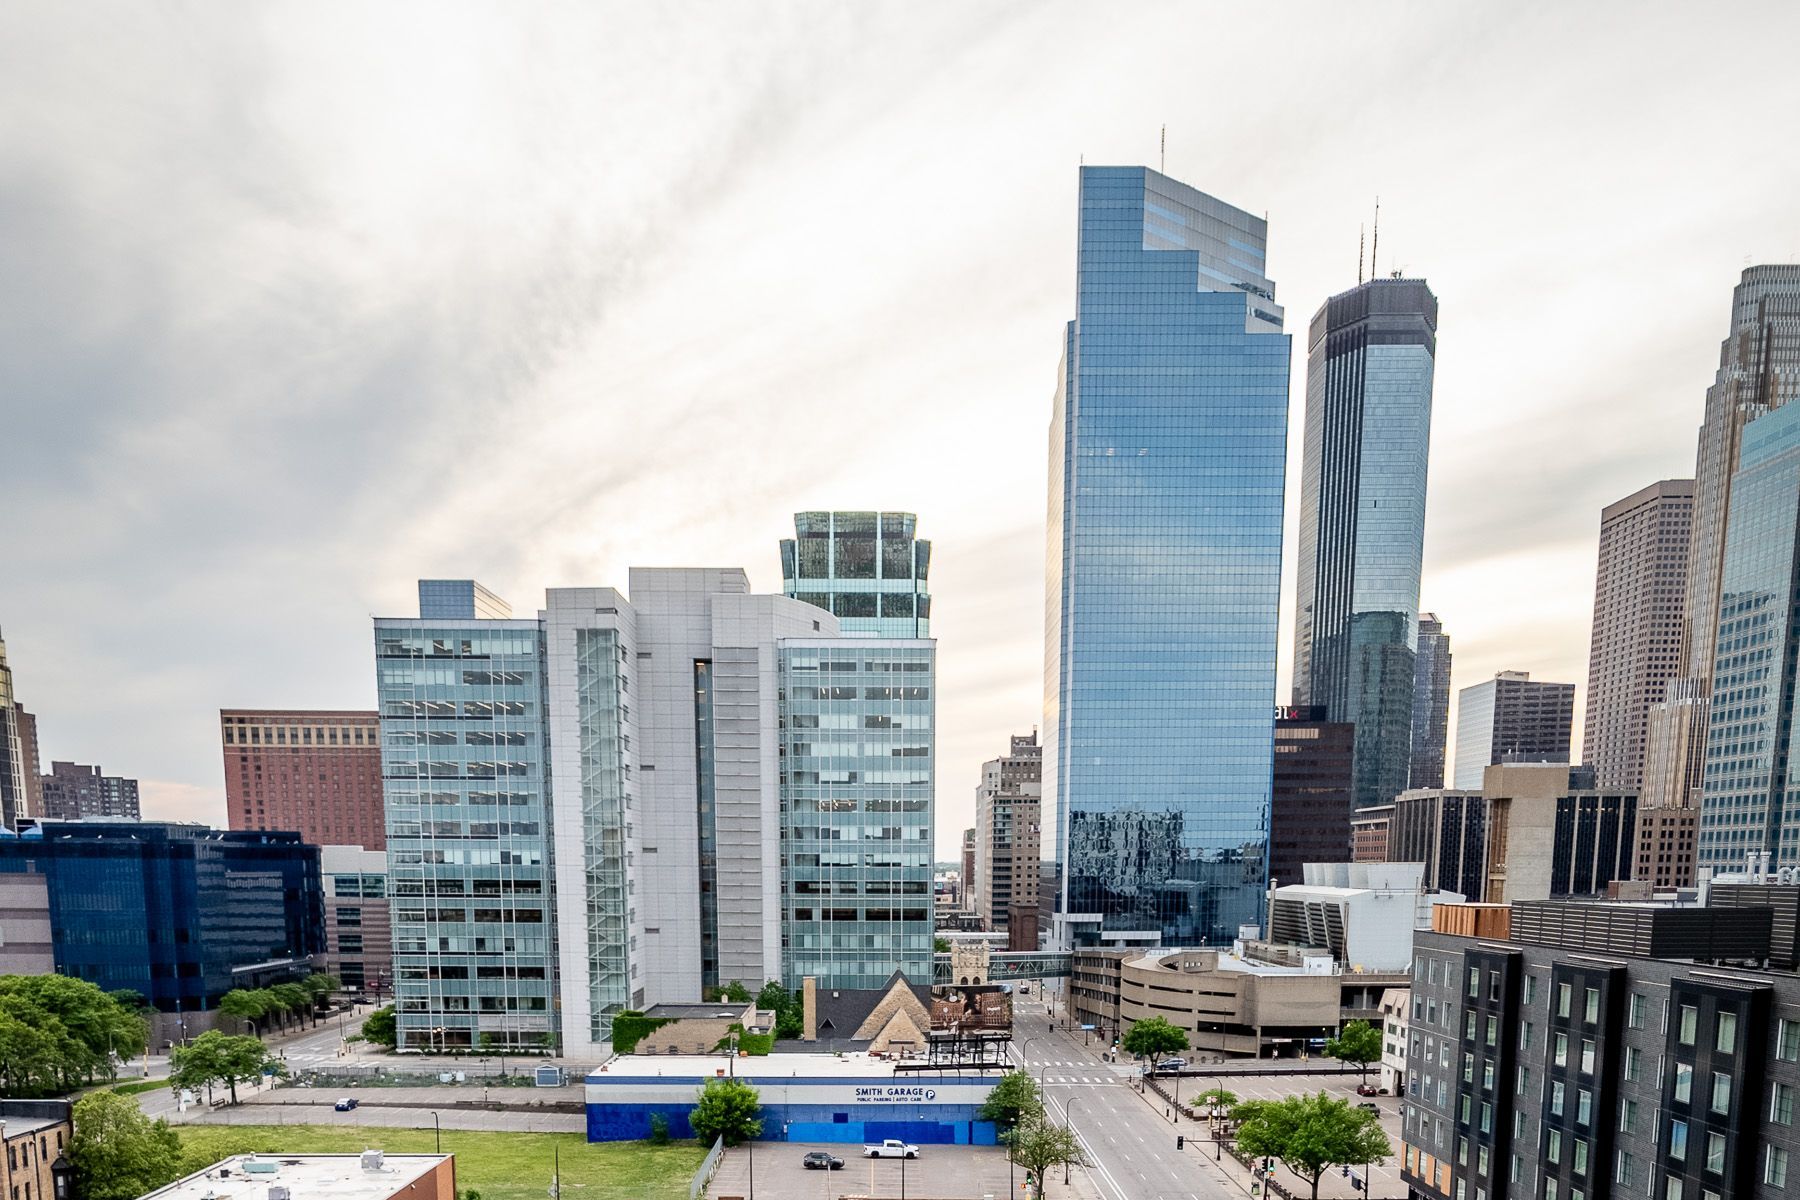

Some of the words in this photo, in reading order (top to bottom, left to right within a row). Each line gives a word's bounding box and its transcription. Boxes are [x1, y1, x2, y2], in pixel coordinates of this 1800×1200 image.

[855, 1088, 882, 1096] SMITH
[887, 1088, 923, 1096] GARAGE
[927, 1090, 935, 1099] P
